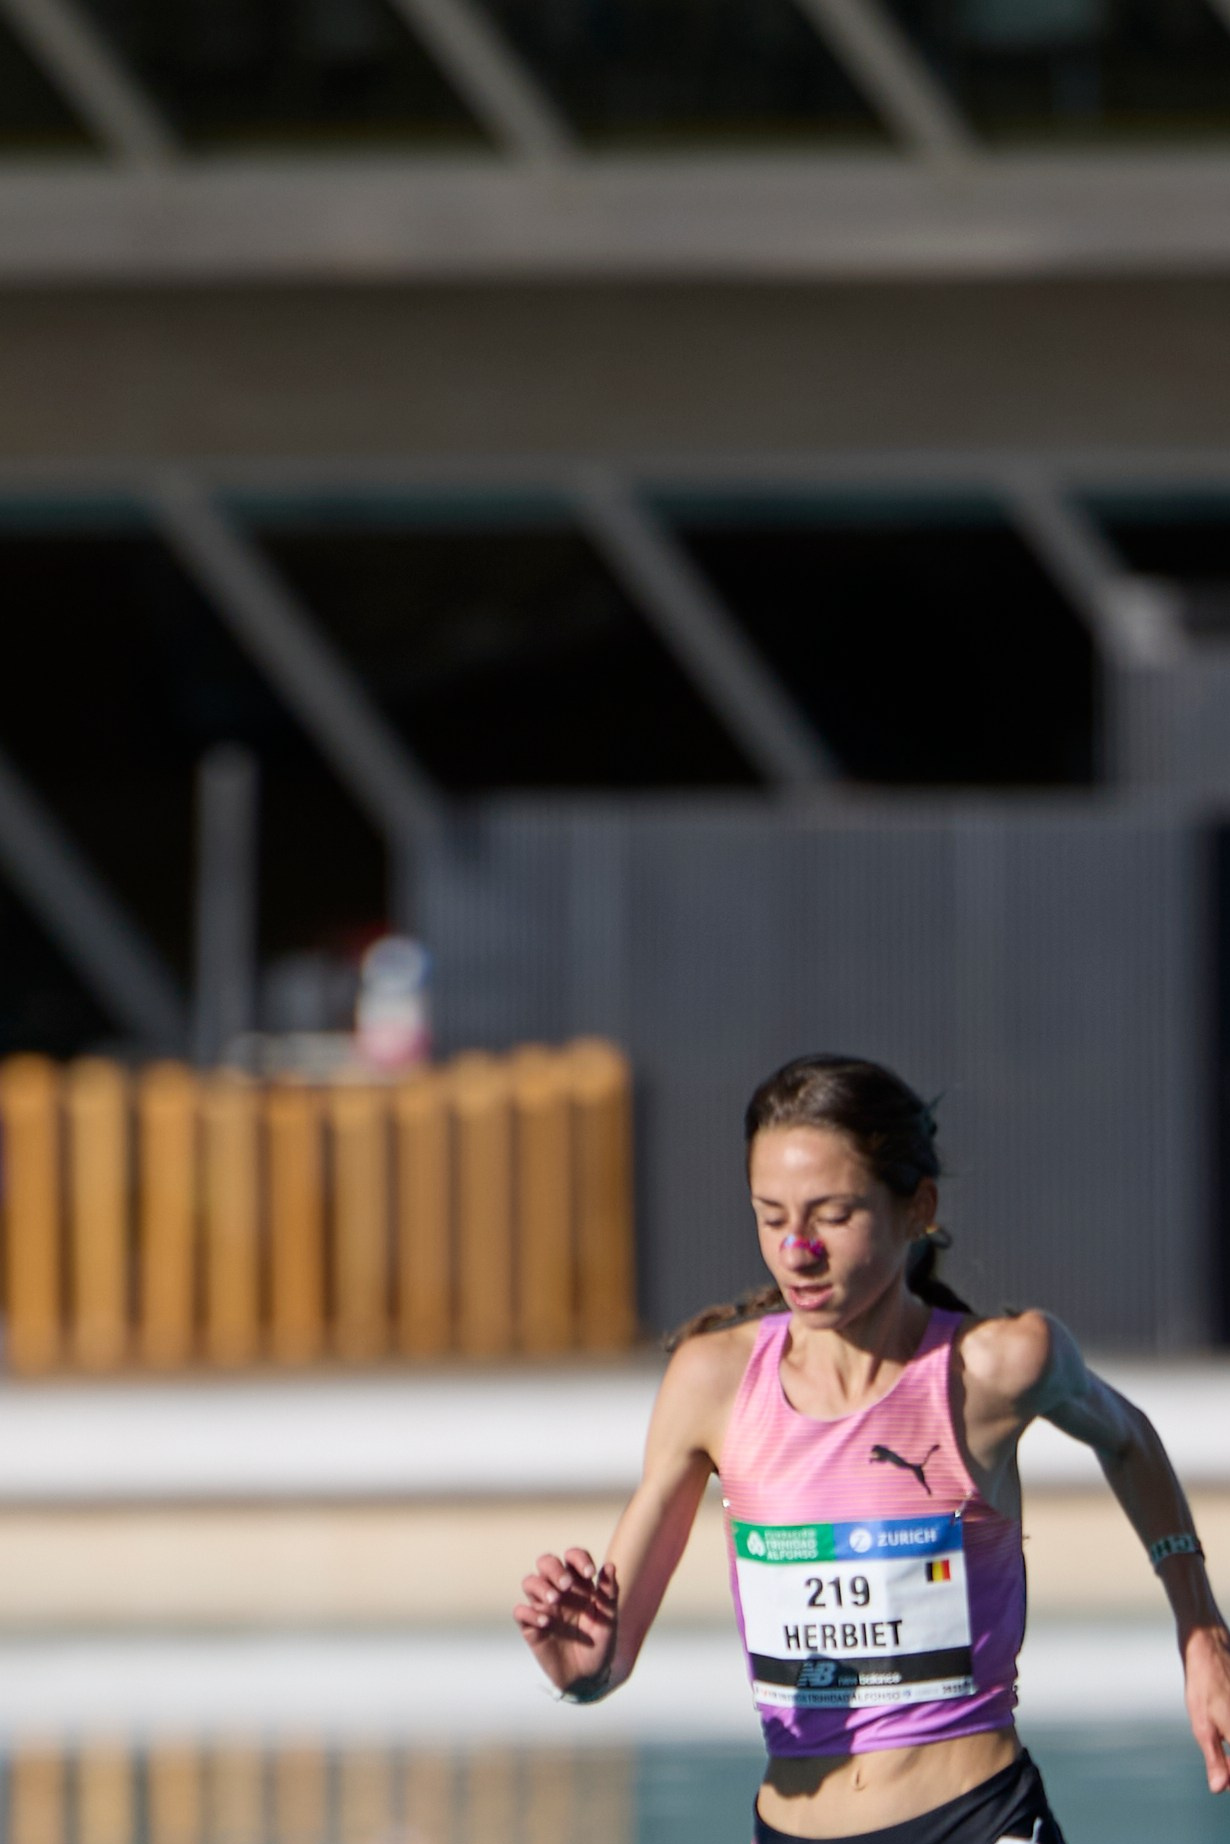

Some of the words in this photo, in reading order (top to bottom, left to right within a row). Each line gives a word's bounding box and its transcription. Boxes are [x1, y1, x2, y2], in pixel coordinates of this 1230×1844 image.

[877, 1528, 937, 1548] ZURICH
[805, 1575, 871, 1608] 219
[783, 1620, 903, 1651] HERBIET
